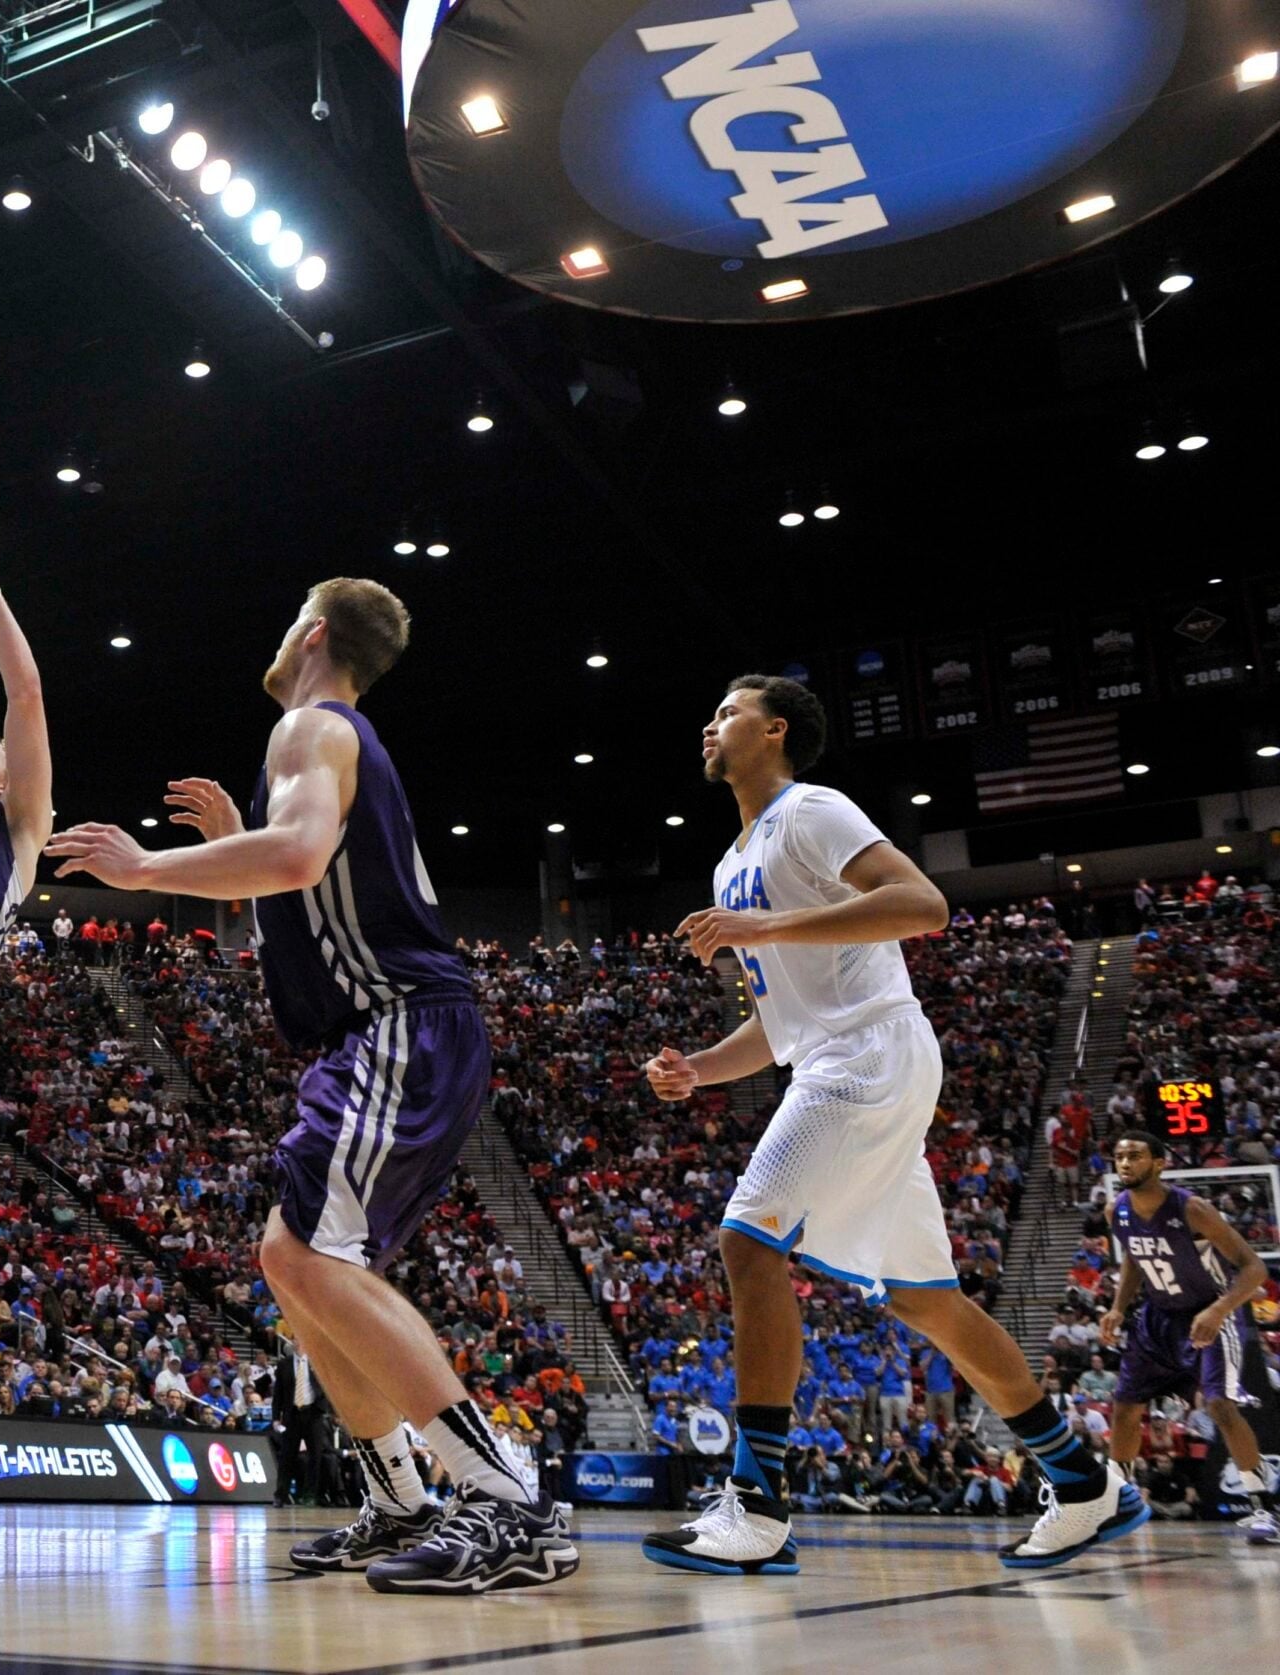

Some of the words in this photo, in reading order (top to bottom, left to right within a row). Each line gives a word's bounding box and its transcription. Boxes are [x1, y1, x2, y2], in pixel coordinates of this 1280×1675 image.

[636, 0, 889, 260] NCAA
[1158, 1082, 1213, 1102] 10:54
[1165, 1102, 1209, 1134] 35
[1128, 1236, 1175, 1256] SFA
[1138, 1259, 1182, 1295] 12
[233, 1452, 267, 1484] LG
[576, 1472, 654, 1488] NCAA.com
